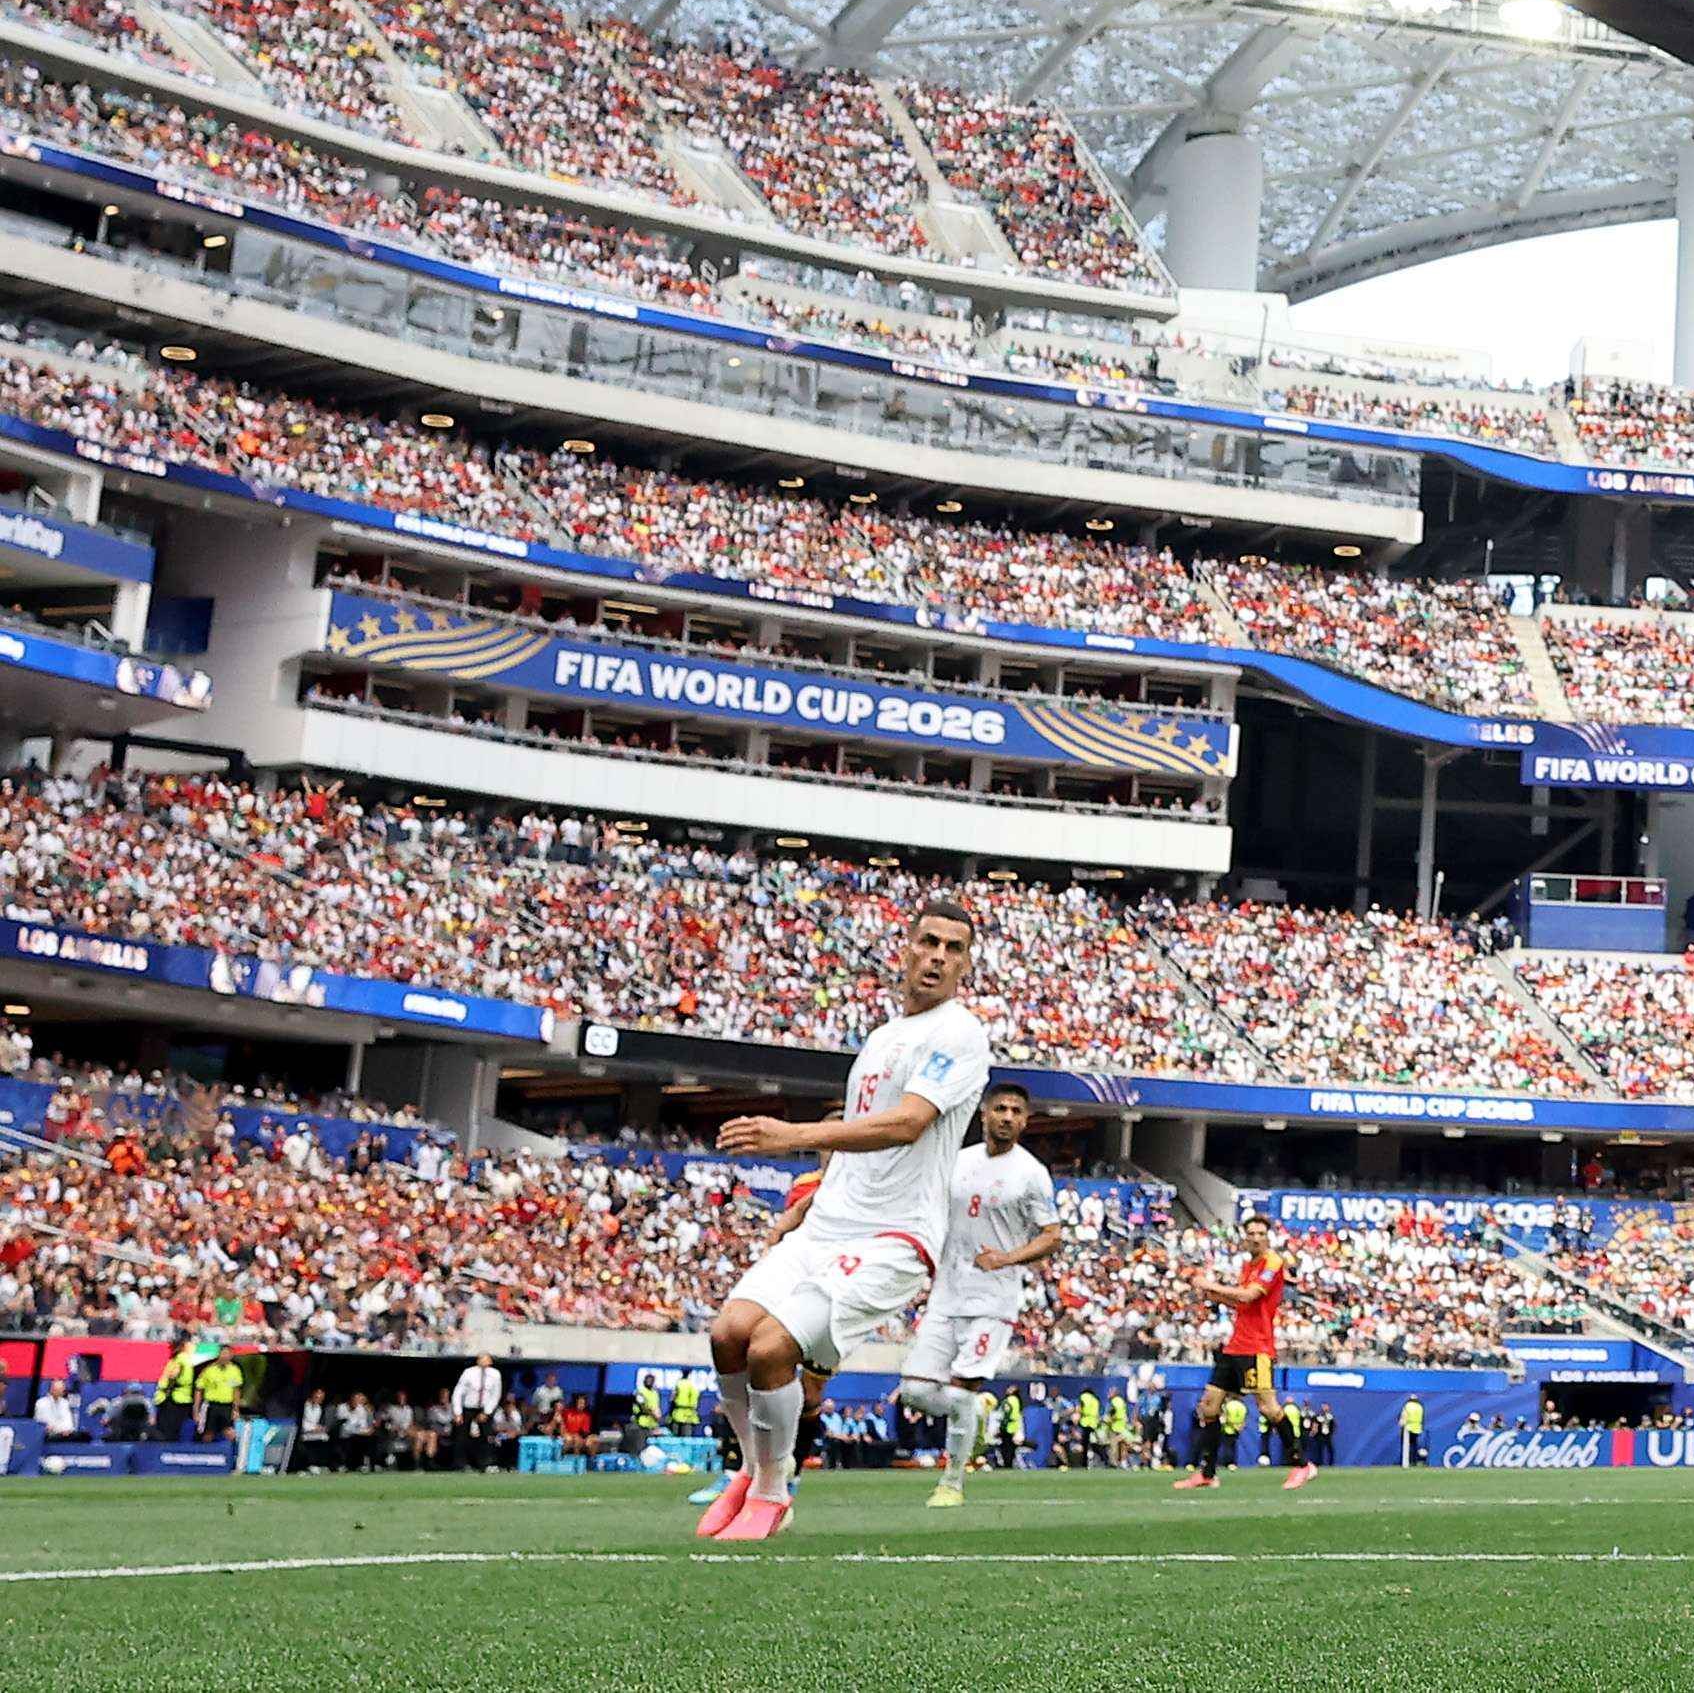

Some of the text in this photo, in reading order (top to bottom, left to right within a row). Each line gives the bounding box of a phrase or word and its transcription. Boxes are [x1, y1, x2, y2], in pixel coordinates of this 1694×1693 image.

[1587, 471, 1627, 490] LOS
[554, 649, 1006, 745] FIFA WORLD CUP 2026
[1534, 757, 1592, 781] FIFA
[1594, 759, 1688, 786] WORLD
[1310, 1091, 1355, 1112] FIFA
[1354, 1093, 1425, 1116] WORLD
[1426, 1096, 1466, 1117] CUP
[968, 1194, 981, 1218] 8
[1281, 1195, 1339, 1220] FIFA
[976, 1334, 990, 1356] 8
[1443, 1429, 1603, 1468] Michelob
